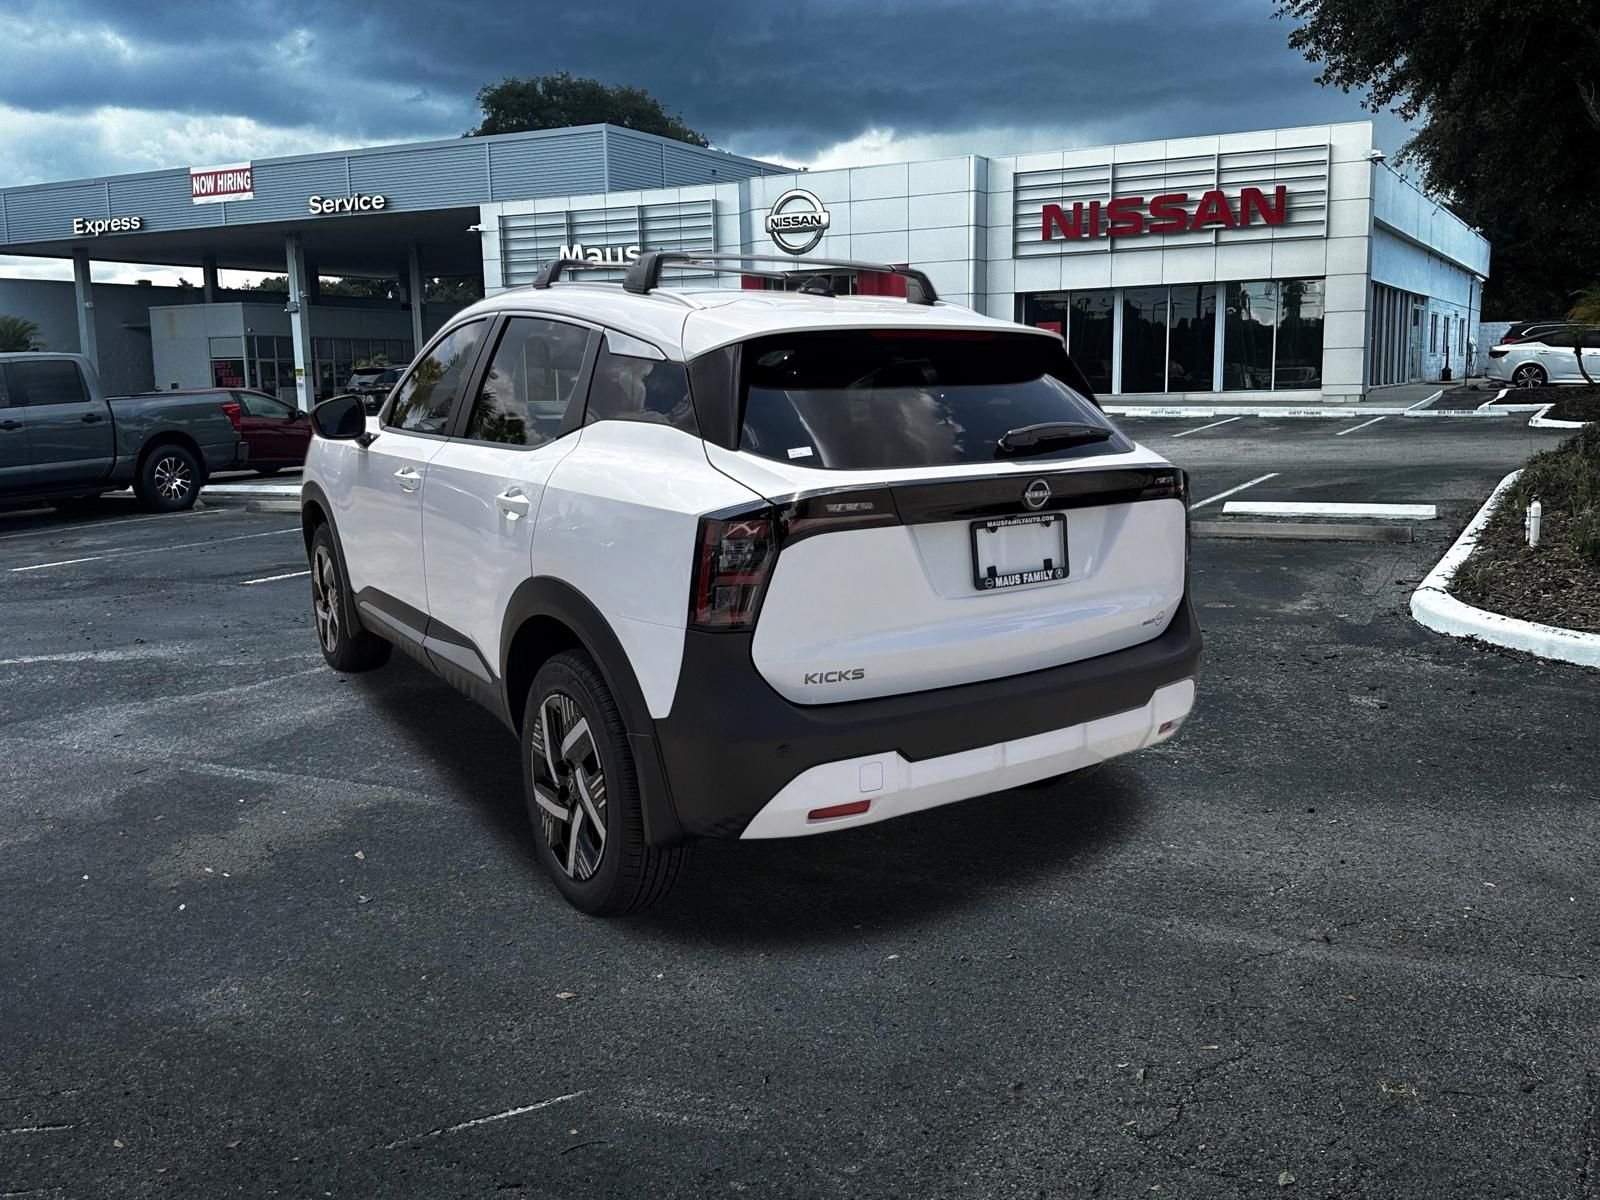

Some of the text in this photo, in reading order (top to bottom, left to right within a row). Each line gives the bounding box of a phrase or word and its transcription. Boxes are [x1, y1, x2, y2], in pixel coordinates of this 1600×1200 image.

[192, 171, 251, 195] NOW HIRING
[309, 192, 385, 214] Service
[770, 215, 822, 228] NISSAN
[1042, 185, 1287, 241] NISSAN
[73, 216, 141, 236] Express
[560, 243, 641, 265] Maus
[222, 376, 244, 386] FREE
[1025, 490, 1051, 499] NISSAN
[987, 515, 1055, 528] MAUSFAMILYAUTO.COM
[995, 569, 1054, 588] MAUS FAMILY
[804, 668, 865, 685] KICKS
